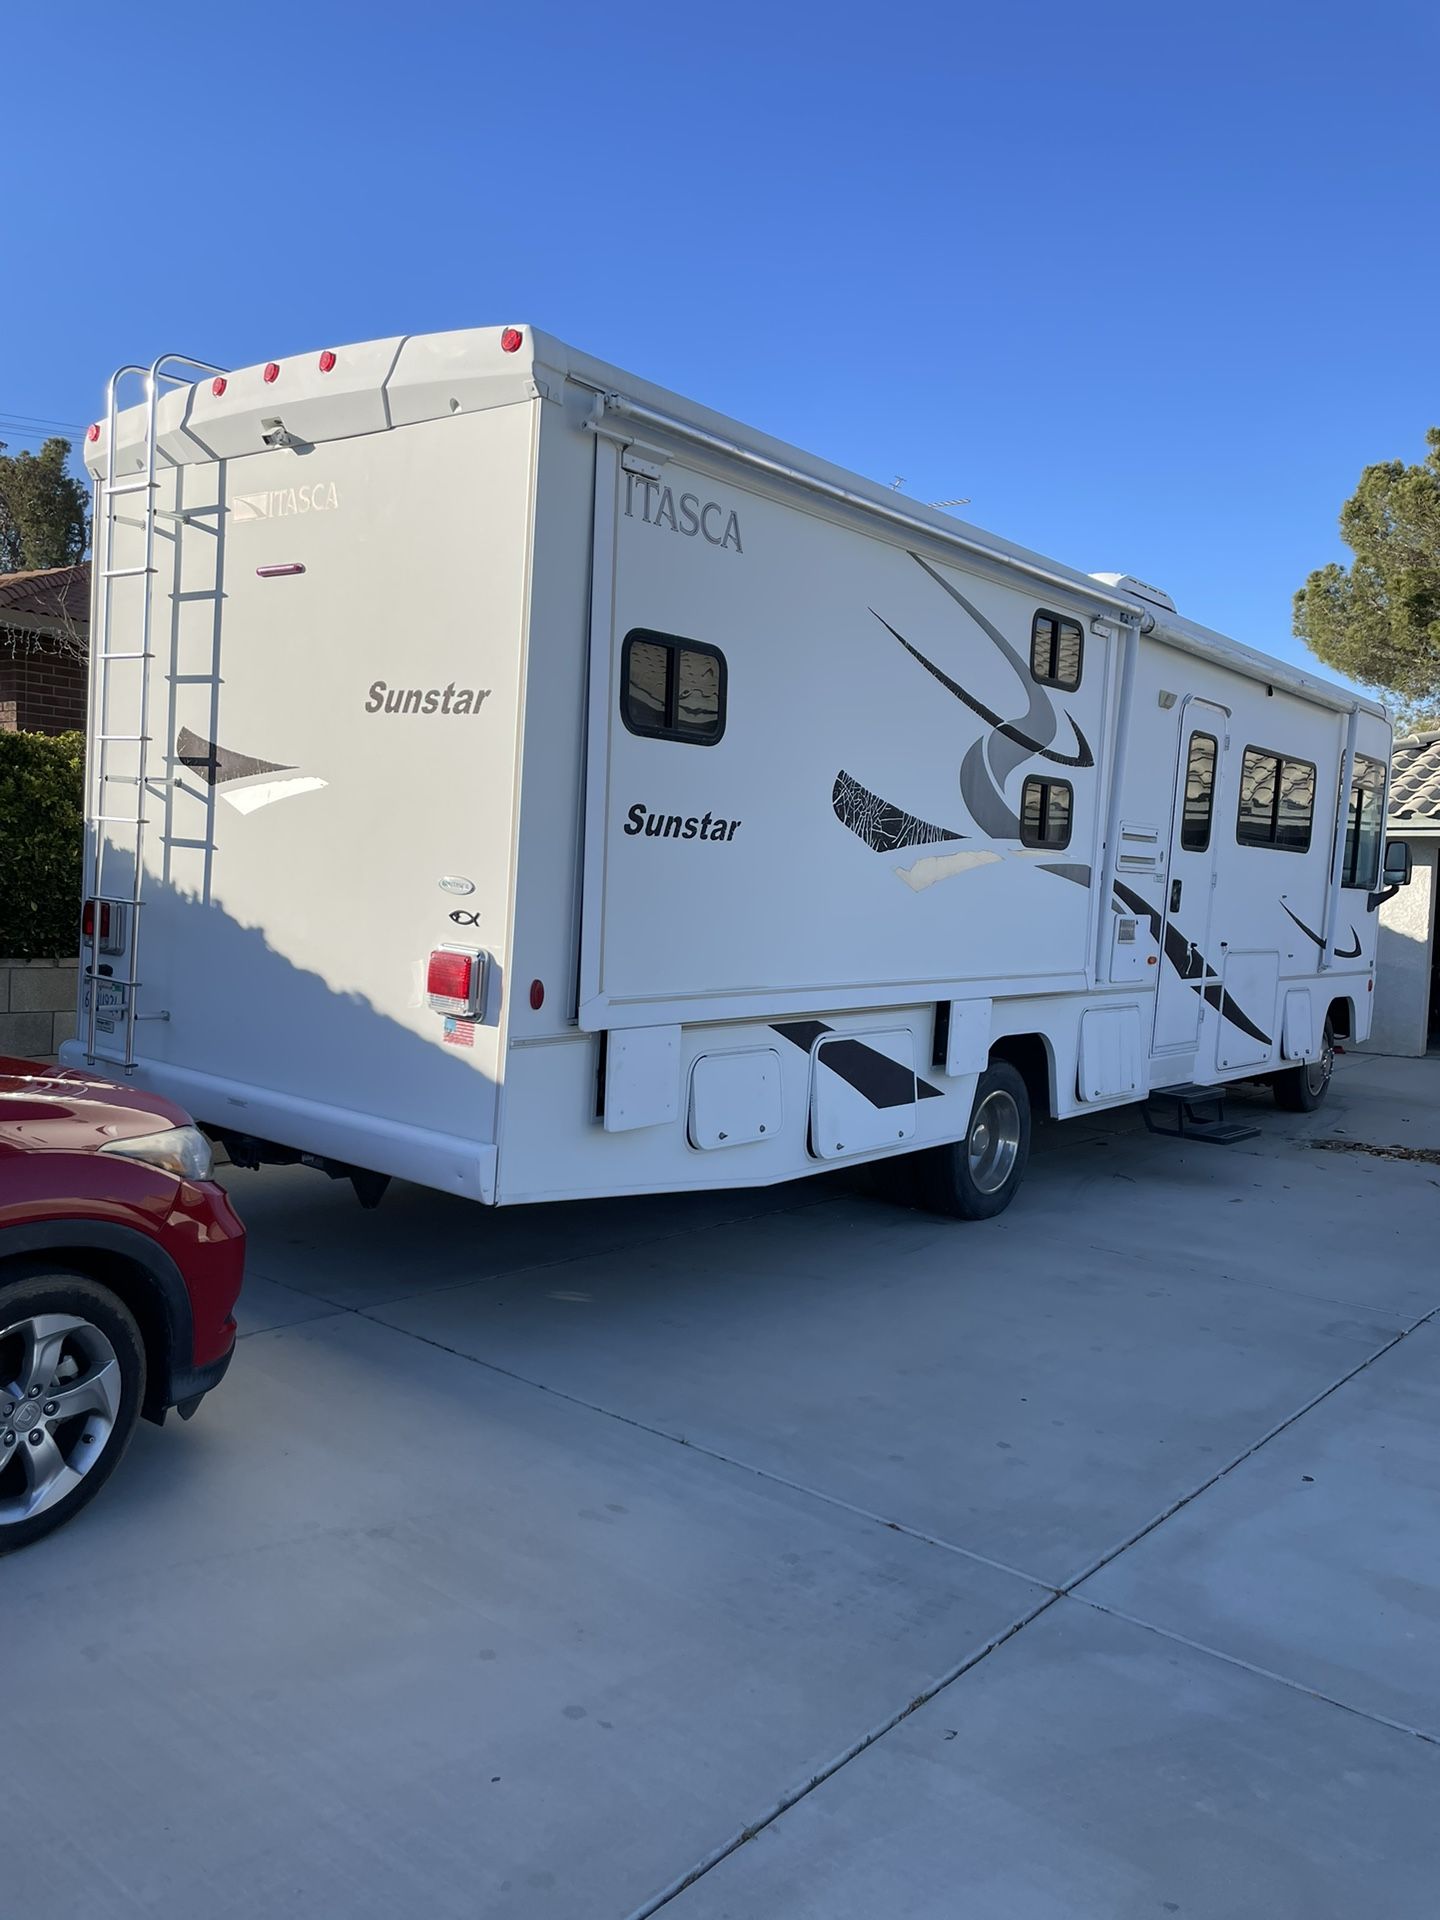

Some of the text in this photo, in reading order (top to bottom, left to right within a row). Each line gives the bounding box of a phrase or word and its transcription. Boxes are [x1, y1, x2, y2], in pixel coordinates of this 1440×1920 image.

[268, 482, 338, 518] ITASCA
[623, 472, 743, 554] ITASCA
[365, 680, 492, 715] Sunstar
[623, 803, 742, 841] Sunstar
